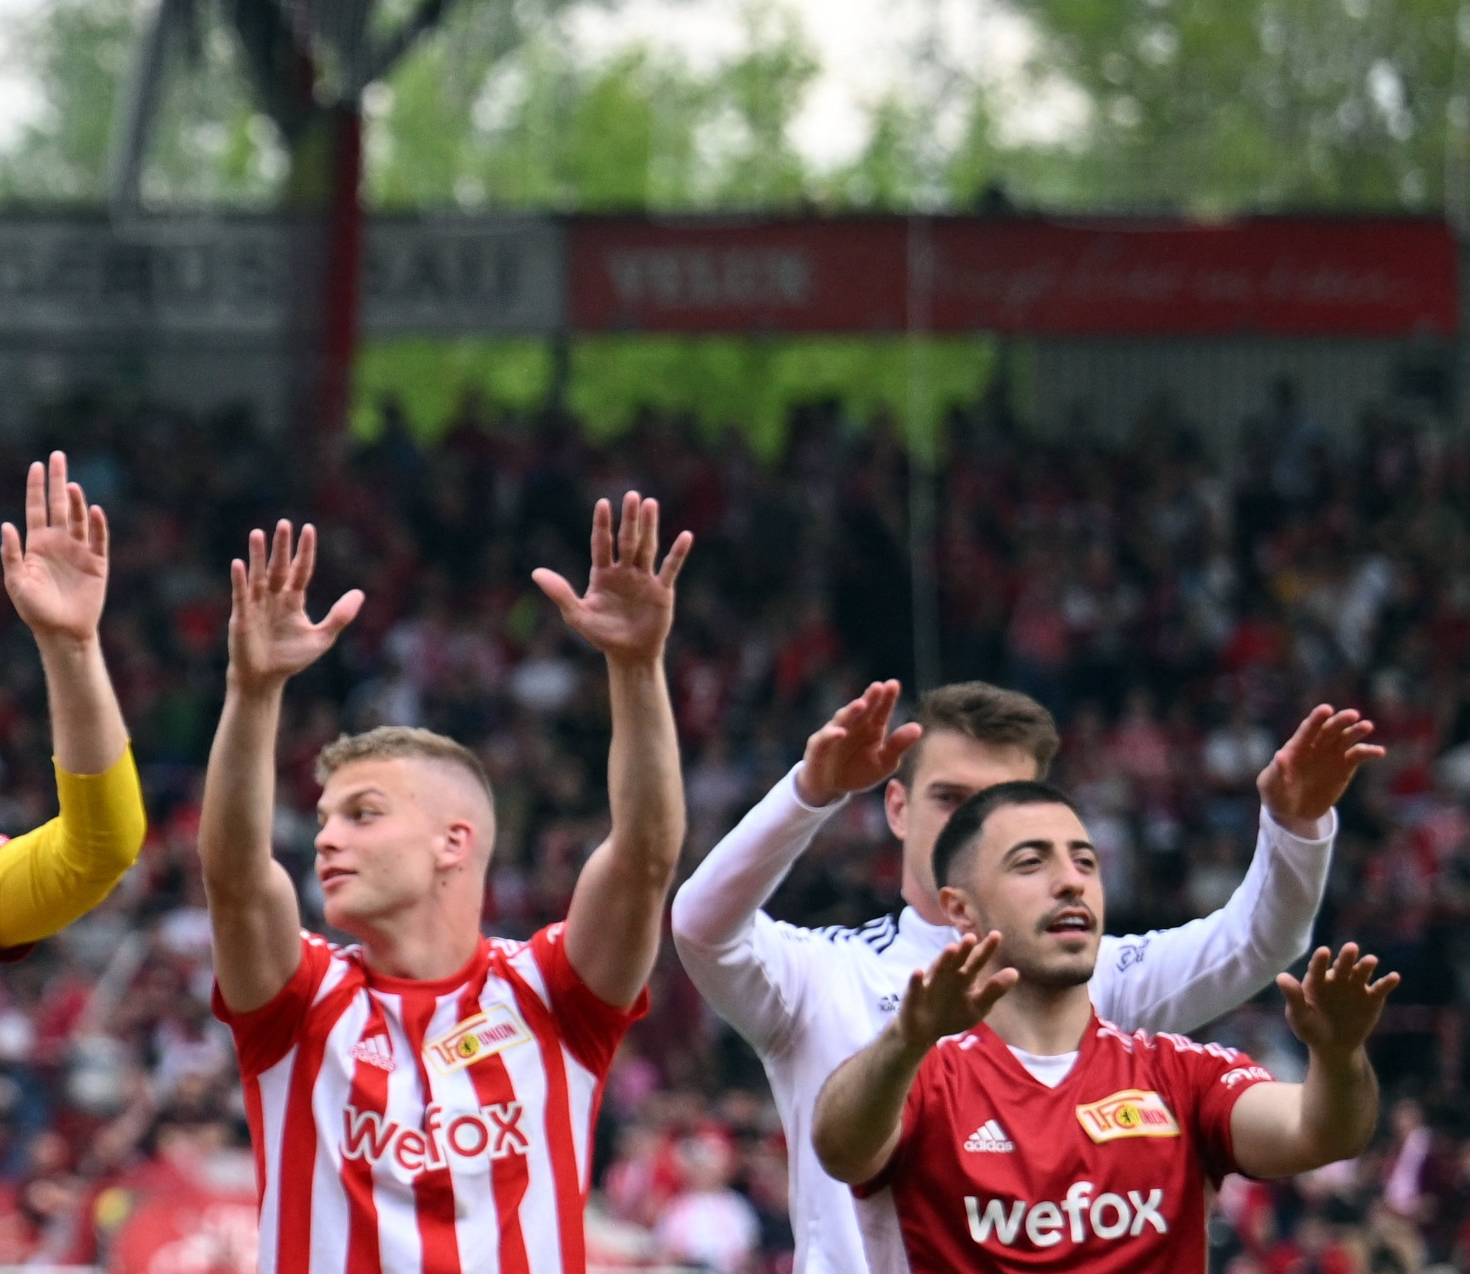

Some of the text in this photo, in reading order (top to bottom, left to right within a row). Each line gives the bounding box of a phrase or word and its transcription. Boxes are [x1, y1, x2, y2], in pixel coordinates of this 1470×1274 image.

[479, 1024, 516, 1045] UNION
[343, 1102, 529, 1173] wefox
[964, 1139, 1013, 1153] adidas
[965, 1181, 1166, 1247] wefox
